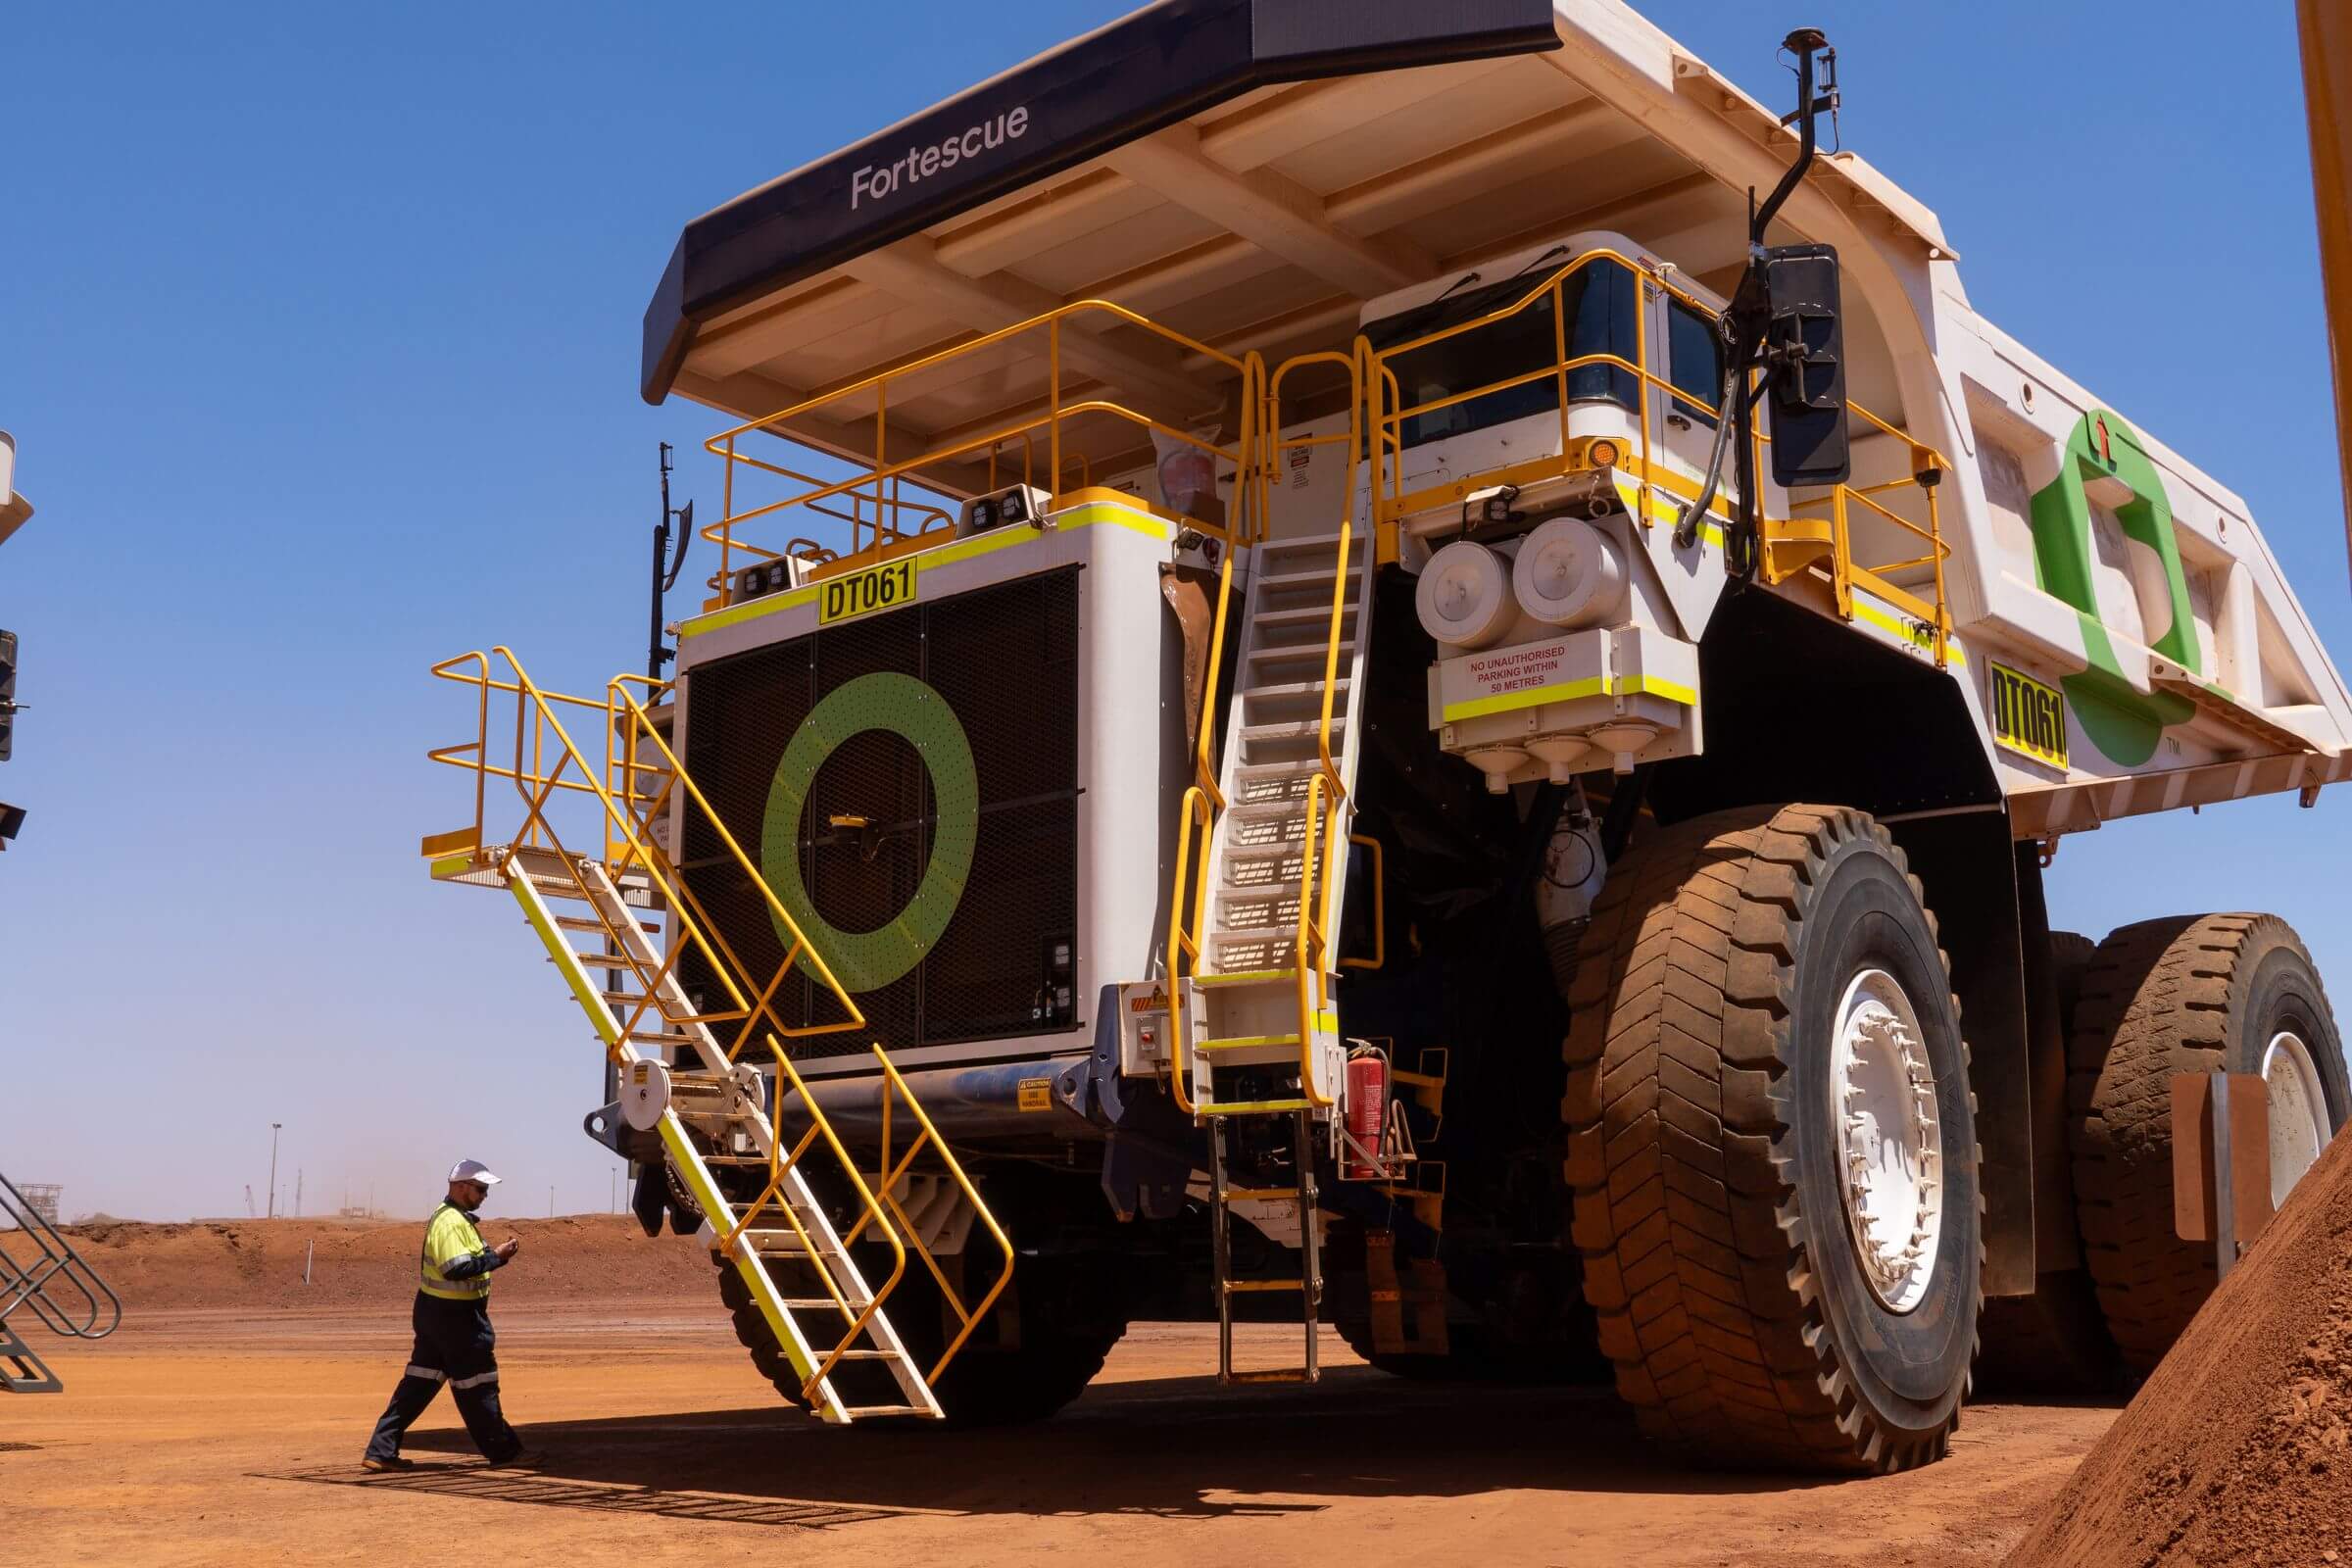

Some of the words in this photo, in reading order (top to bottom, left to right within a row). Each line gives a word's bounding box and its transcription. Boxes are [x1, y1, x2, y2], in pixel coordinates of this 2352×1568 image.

[852, 106, 1028, 210] Fortescue
[827, 563, 909, 617] DT061
[1471, 662, 1485, 672] NO
[1488, 647, 1565, 668] UNAUTHORISED
[1478, 667, 1521, 683] PARKING
[1523, 661, 1558, 674] WITHIN
[1491, 683, 1501, 693] 50
[1504, 675, 1544, 691] METRES
[1992, 667, 2066, 761] DT061
[2167, 736, 2180, 755] TM
